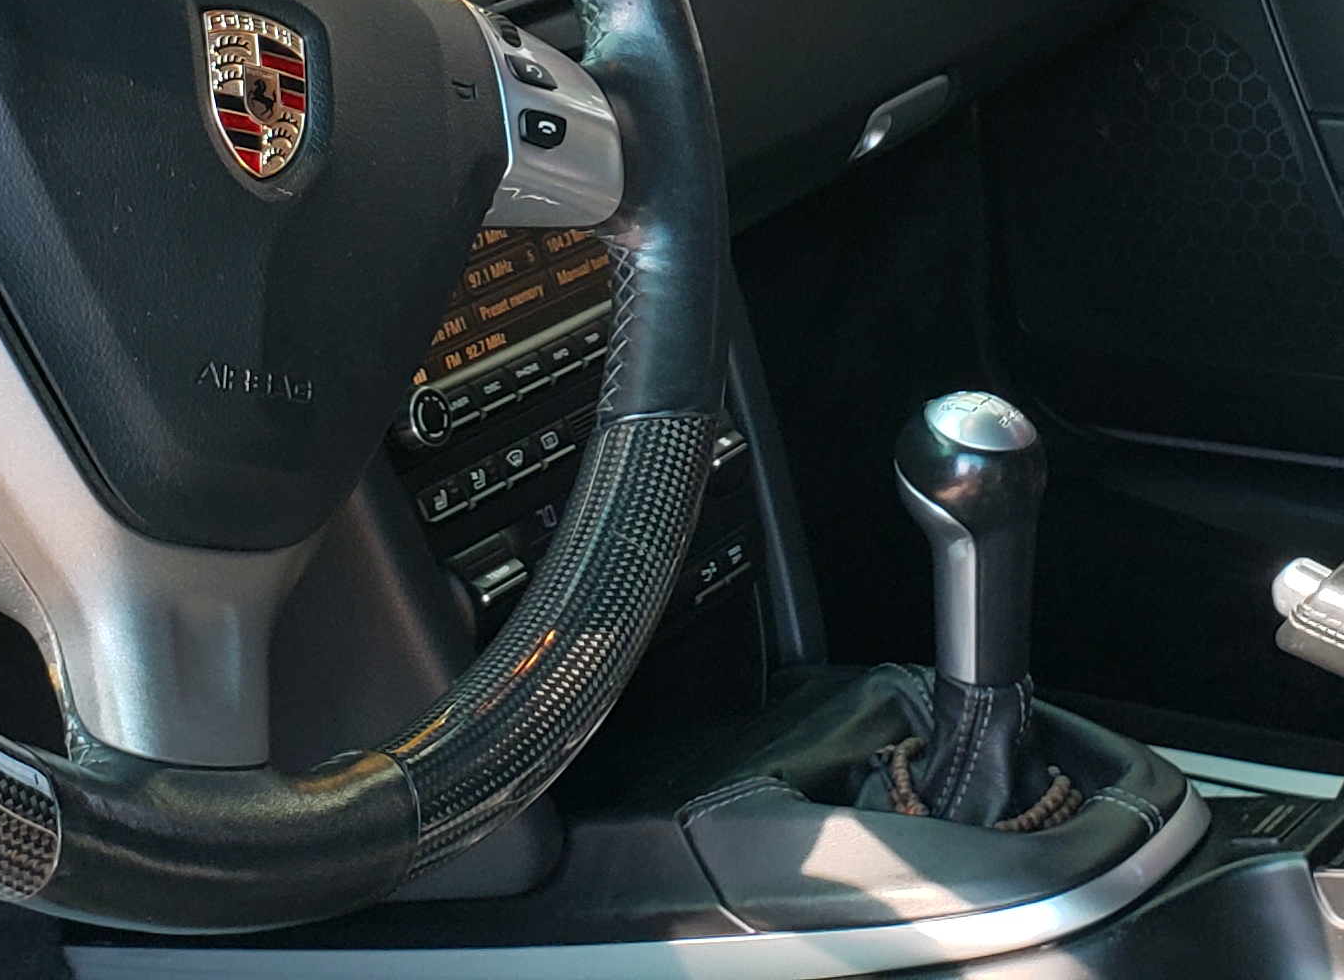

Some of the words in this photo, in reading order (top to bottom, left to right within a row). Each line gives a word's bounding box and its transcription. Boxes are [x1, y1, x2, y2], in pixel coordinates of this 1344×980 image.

[467, 269, 491, 289] 97.1
[490, 260, 514, 279] MHz
[556, 259, 591, 285] Manual
[479, 298, 510, 321] Preset
[509, 284, 545, 308] memory
[444, 315, 467, 338] FM1
[445, 351, 462, 370] FM
[465, 340, 485, 360] 92.7
[485, 333, 507, 351] MHz
